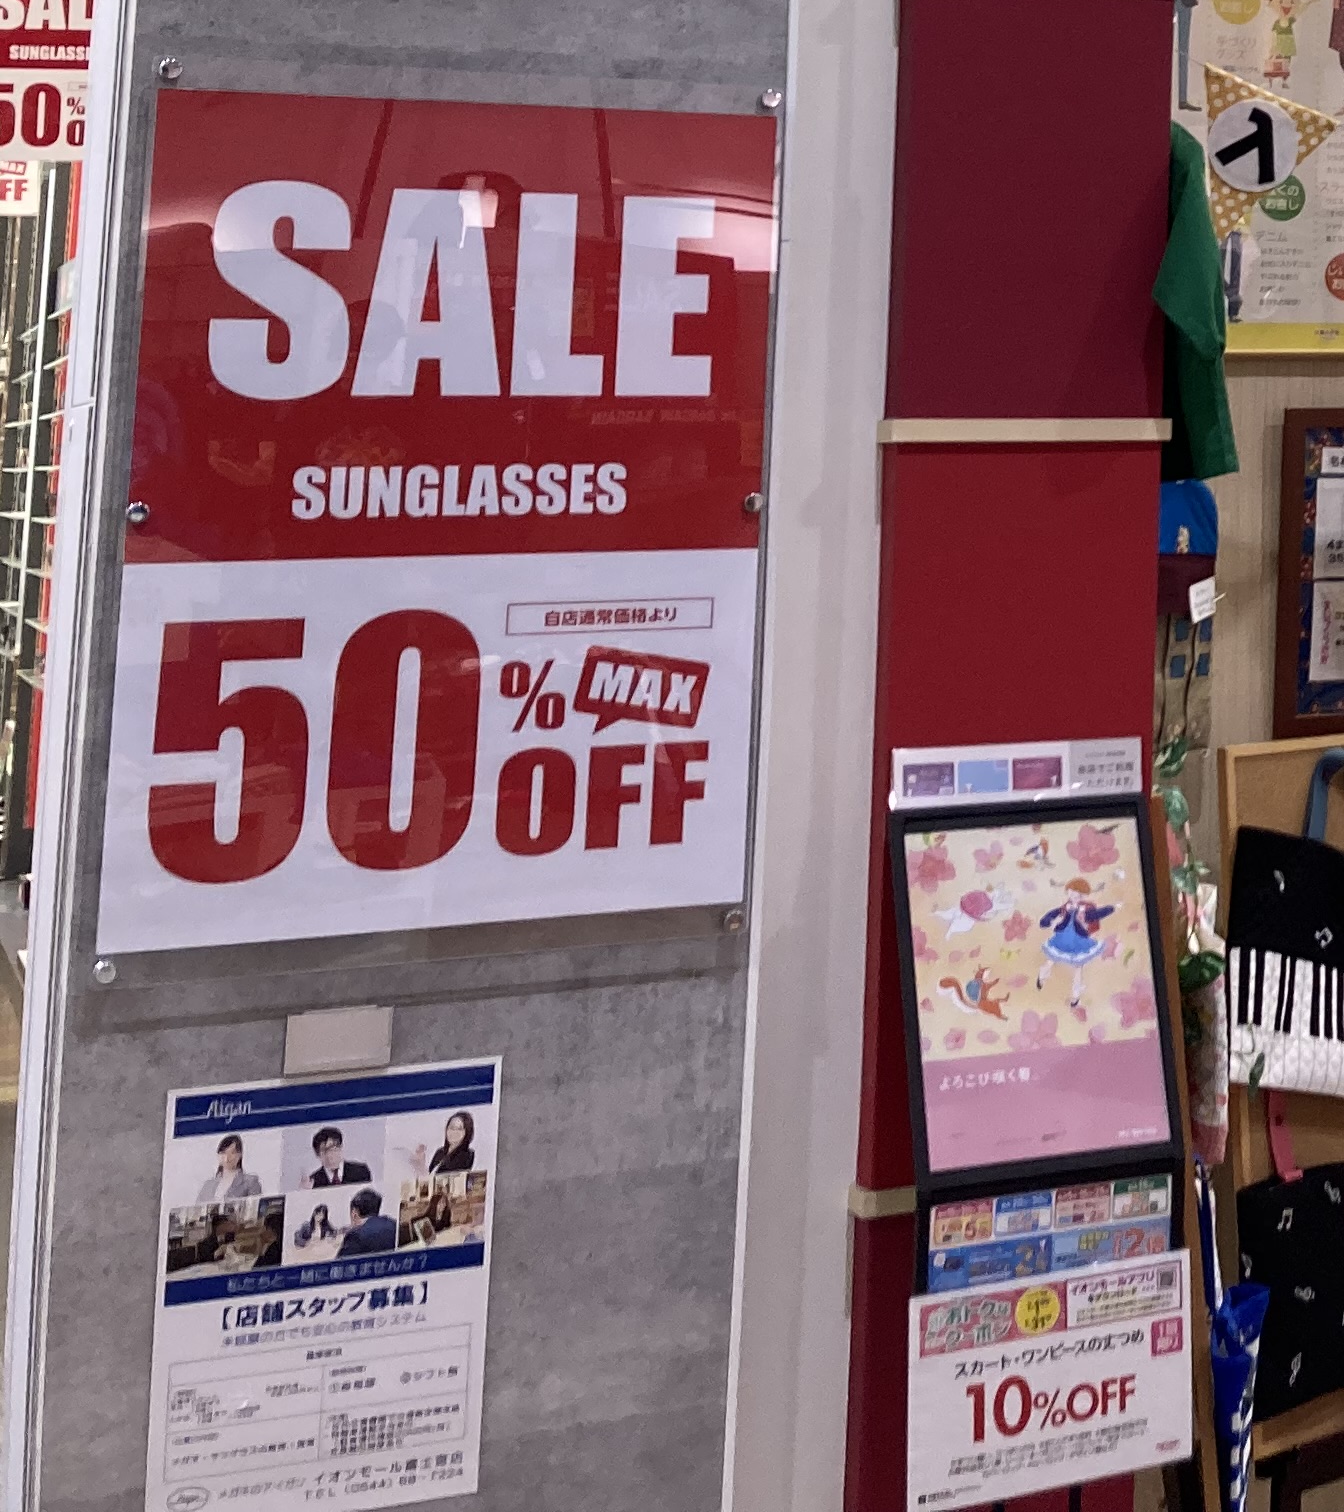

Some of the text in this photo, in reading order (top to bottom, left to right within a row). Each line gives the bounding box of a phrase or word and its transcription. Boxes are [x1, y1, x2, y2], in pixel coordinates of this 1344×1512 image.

[9, 45, 90, 62] SUNGLASS
[0, 178, 28, 201] FF
[207, 179, 717, 401] SALE
[292, 462, 628, 521] SUNGLASSES
[543, 606, 678, 627] 自店通常価格より
[588, 659, 699, 715] MAX
[146, 608, 480, 885] 50
[496, 740, 711, 857] OFF
[965, 1373, 1138, 1445] 10%OFF
